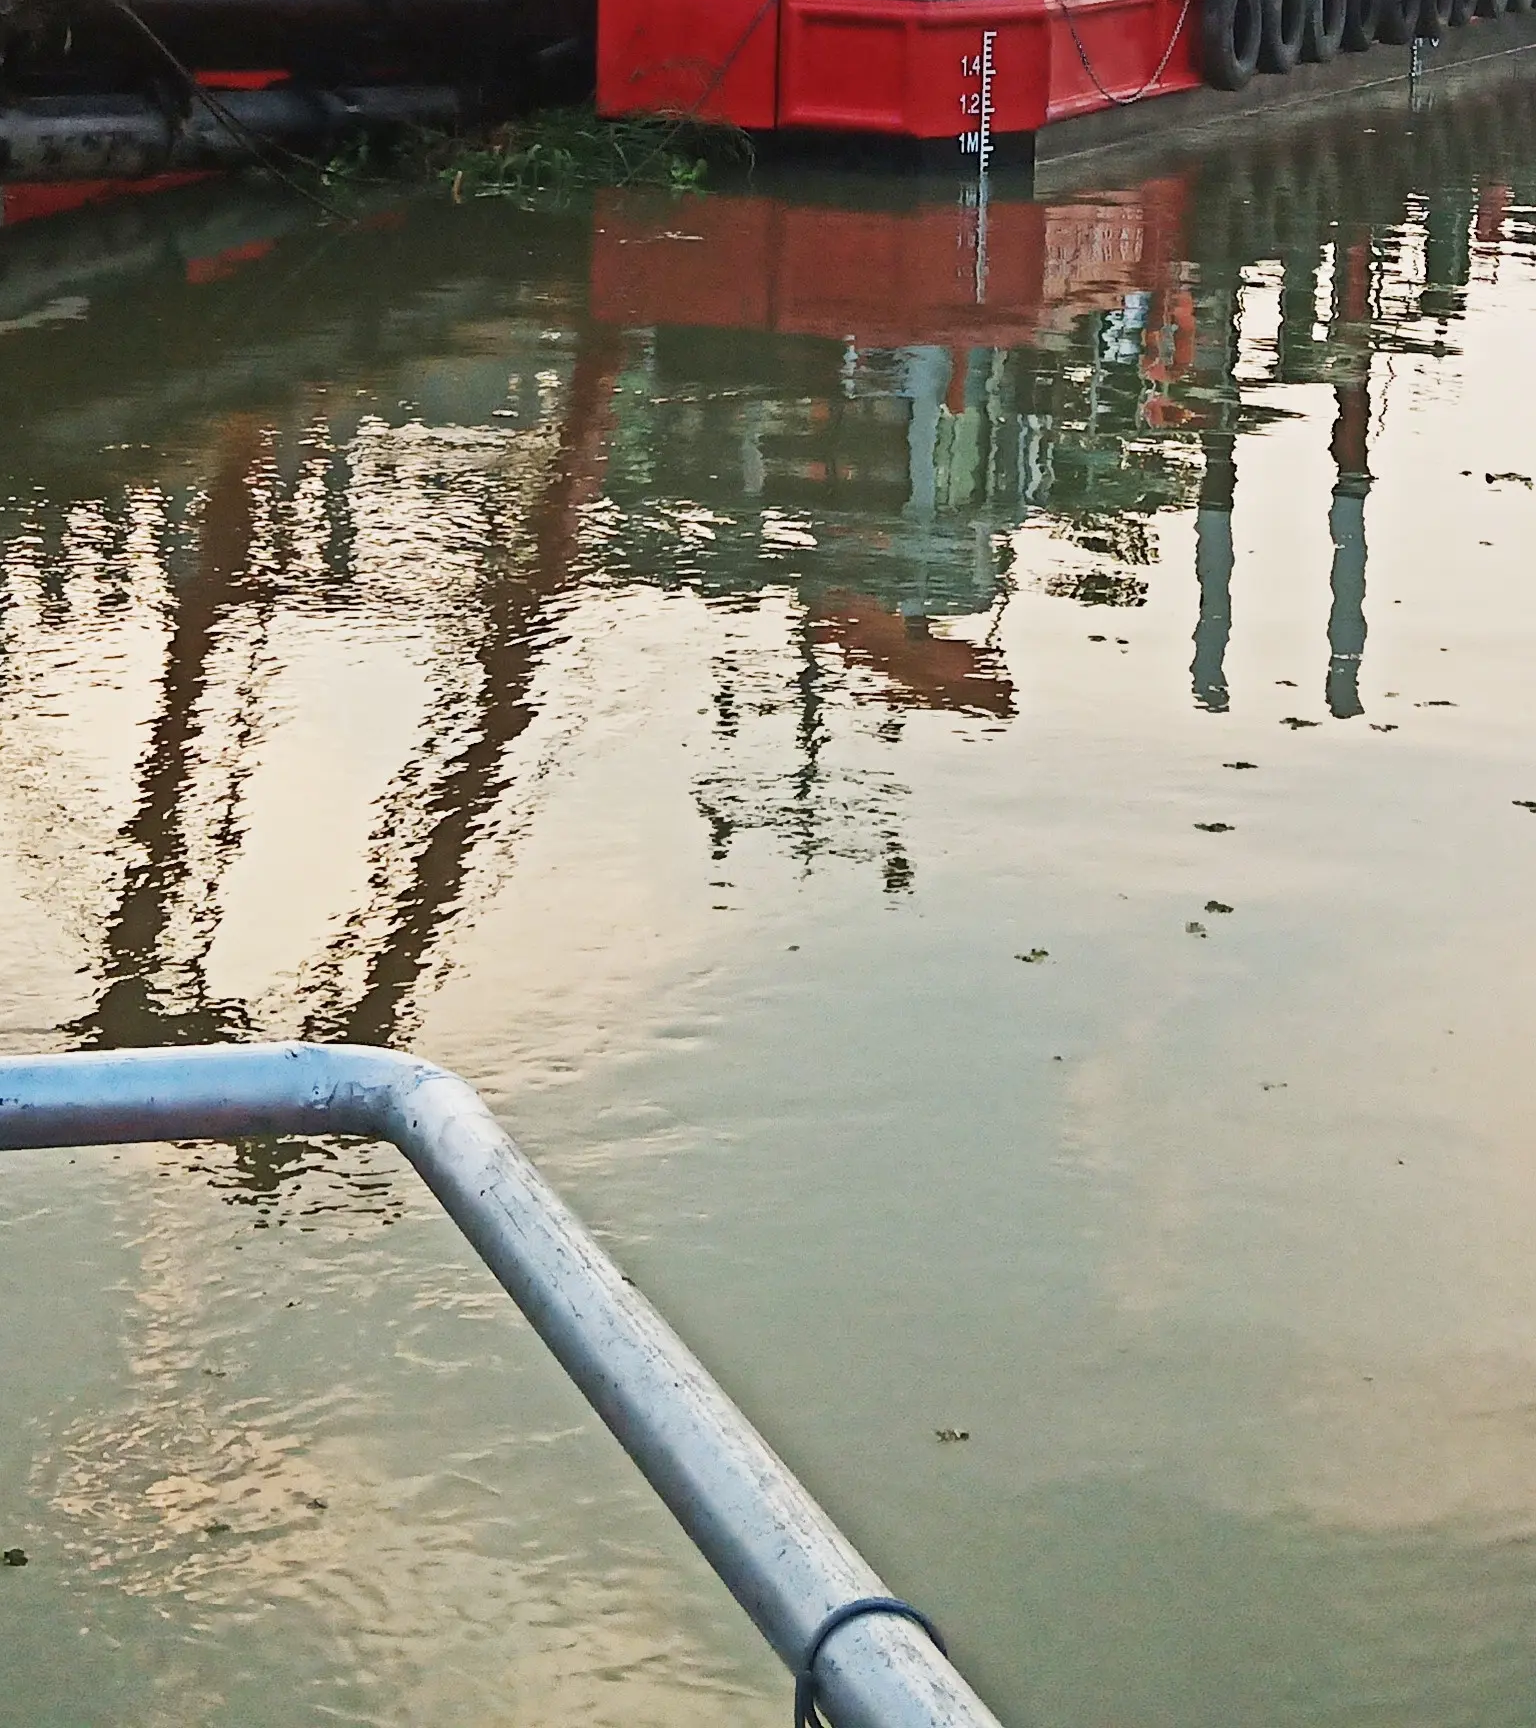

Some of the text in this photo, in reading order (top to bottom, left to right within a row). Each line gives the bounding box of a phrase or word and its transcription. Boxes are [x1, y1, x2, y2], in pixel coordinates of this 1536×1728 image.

[961, 55, 981, 77] 1.4
[960, 93, 980, 115] 1.2
[958, 131, 979, 154] 1M
